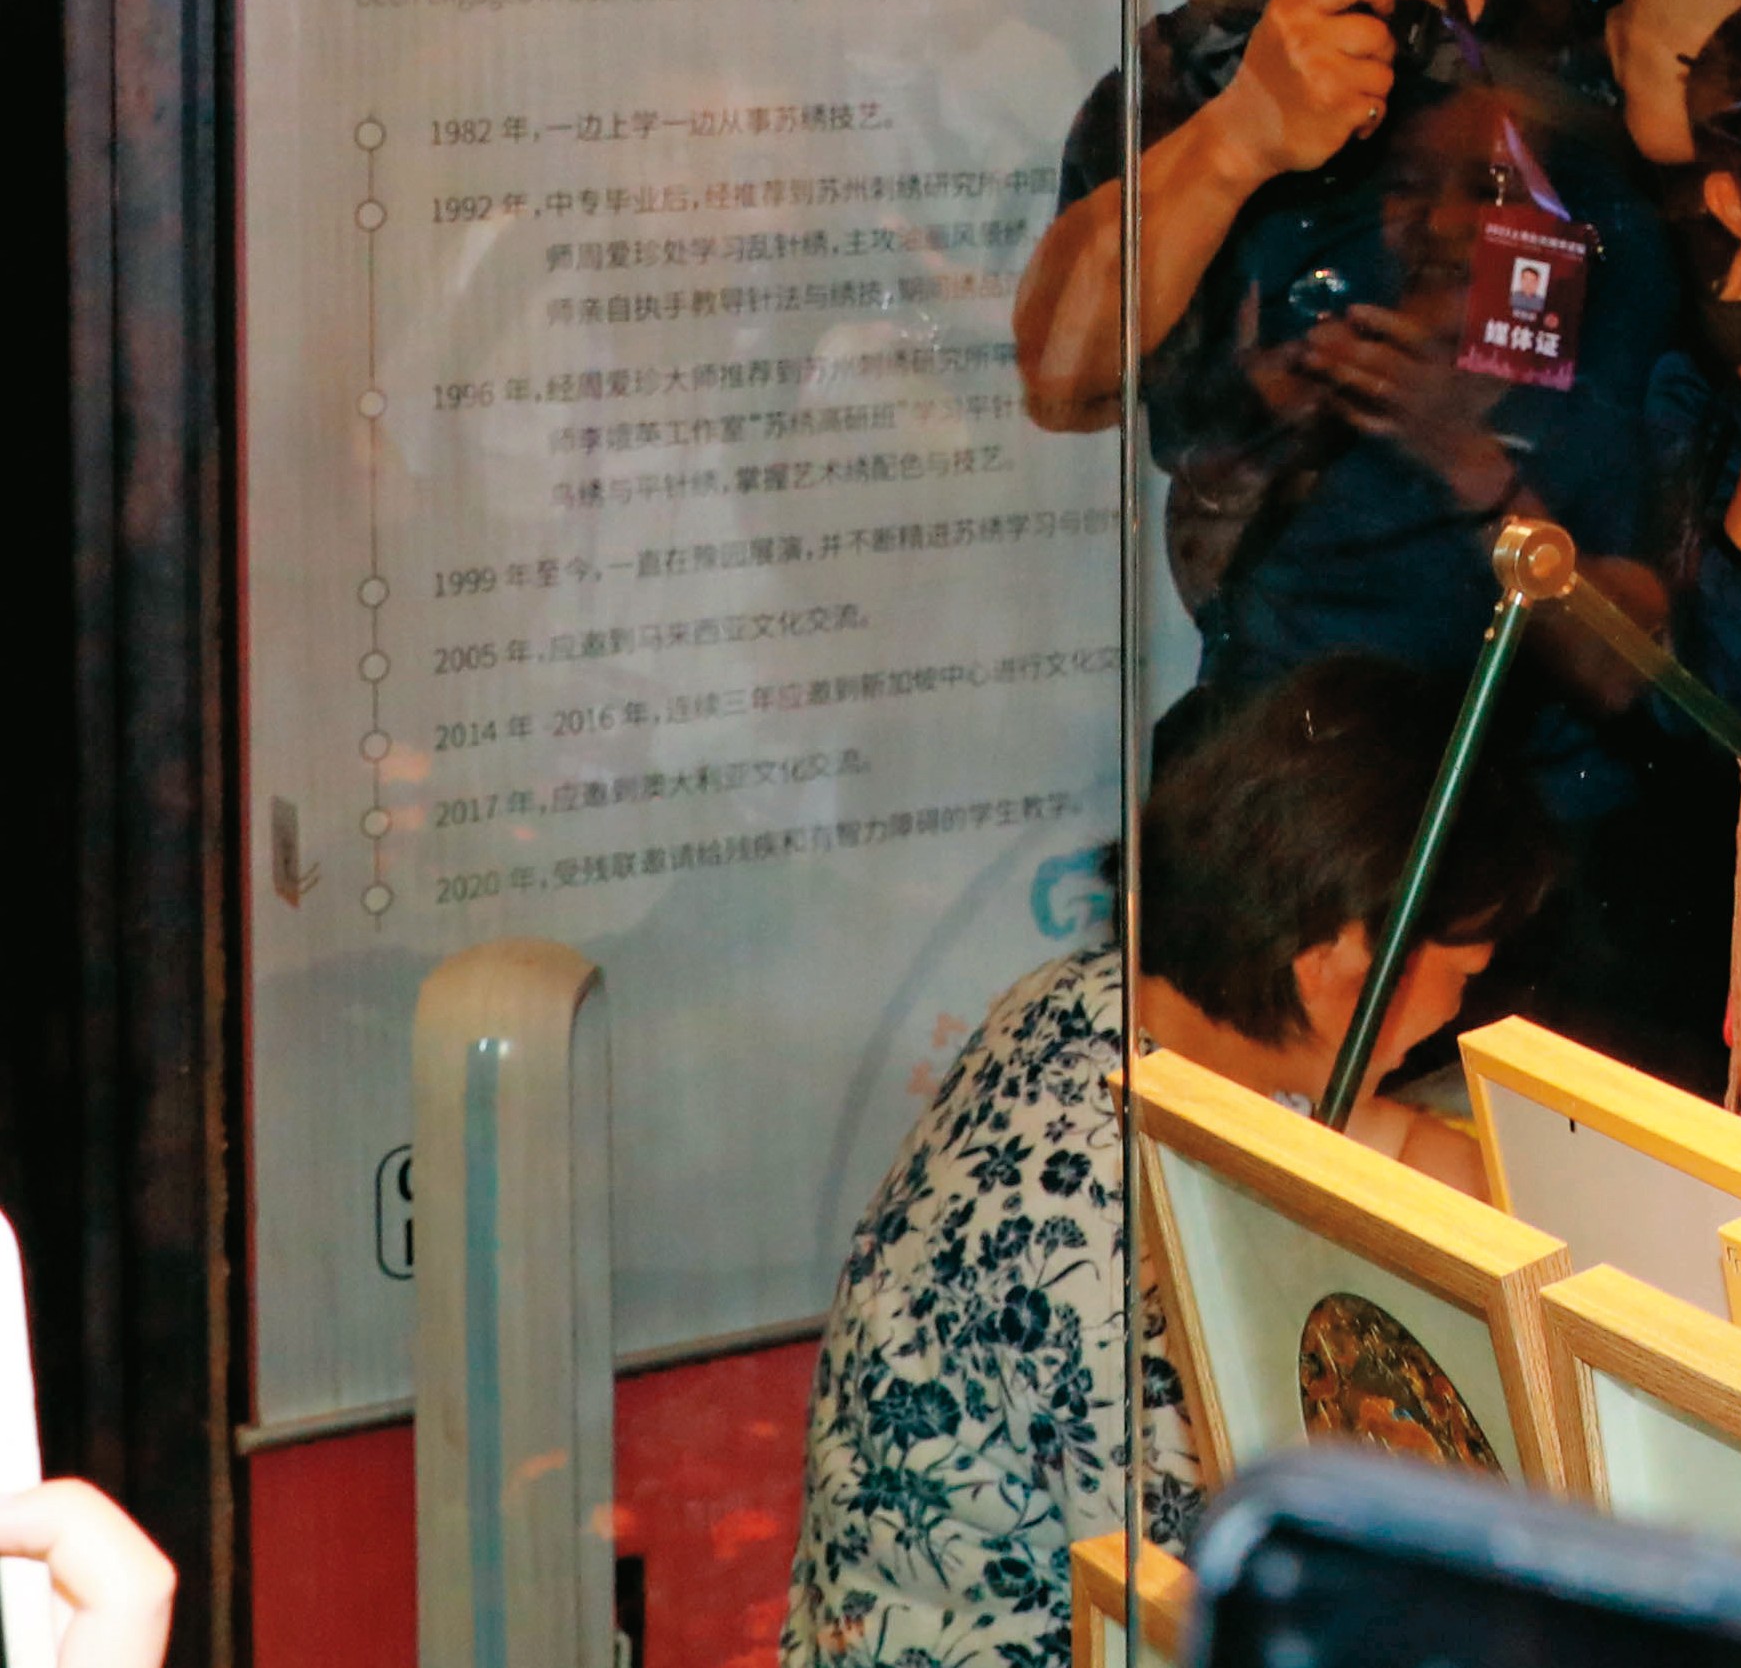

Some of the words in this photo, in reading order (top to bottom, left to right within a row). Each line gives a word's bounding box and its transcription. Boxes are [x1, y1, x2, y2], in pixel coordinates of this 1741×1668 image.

[430, 118, 492, 146] 1982
[431, 194, 494, 224] 1992
[432, 381, 495, 411] 1996
[433, 566, 498, 599] 1999
[433, 644, 499, 676] 2005
[434, 719, 498, 751] 2014
[434, 795, 499, 828] 2017
[435, 871, 501, 904] 2020
